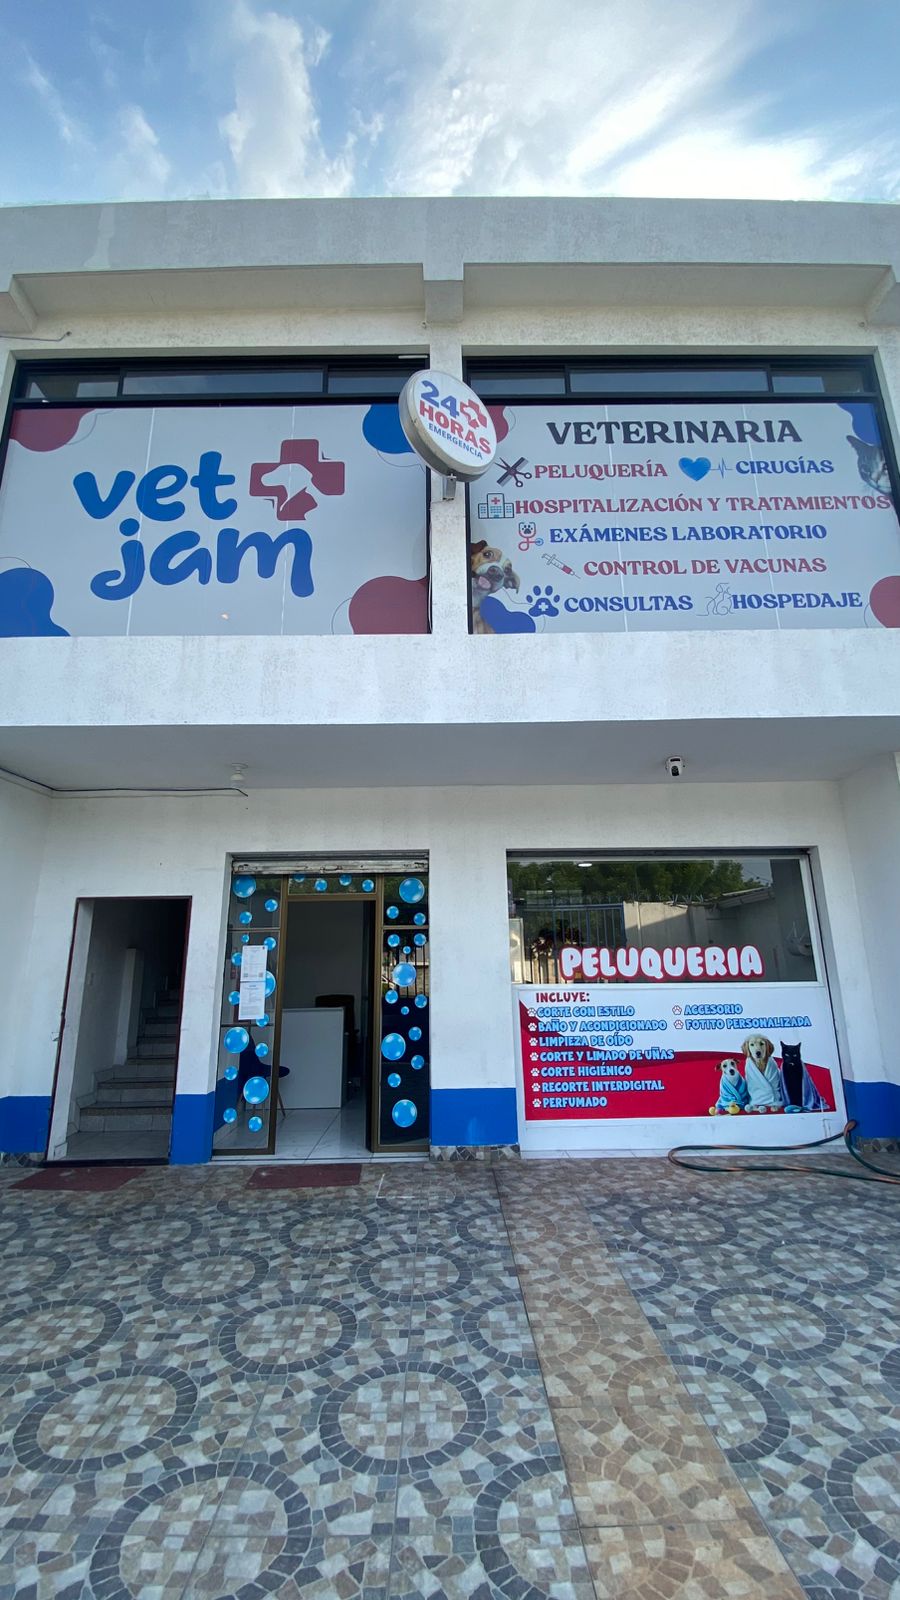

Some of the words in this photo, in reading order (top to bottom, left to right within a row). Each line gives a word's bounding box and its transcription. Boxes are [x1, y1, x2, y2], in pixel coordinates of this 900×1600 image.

[421, 380, 459, 418] 24
[420, 400, 491, 454] HORAS
[546, 420, 802, 445] VETERINARIA
[428, 423, 483, 460] EMERGENCIA
[534, 459, 668, 480] PELUQUERÍA
[735, 456, 834, 474] CIRUGÍAS
[73, 451, 237, 521] vet
[515, 493, 703, 514] HOSPITALIZACIÓN
[707, 497, 720, 511] Y
[726, 495, 891, 511] TRATAMIENTOS
[550, 523, 668, 543] EXÁMENES
[672, 525, 827, 541] LABORATORIO
[90, 518, 314, 601] jam
[583, 560, 687, 576] CONTROL
[691, 559, 720, 574] DE
[724, 558, 827, 573] VACUNAS
[564, 595, 693, 613] CONSULTAS
[731, 592, 863, 609] HOSPEDAJE
[560, 944, 765, 980] PELUQUERIA
[536, 992, 590, 1003] INCLUYE:
[536, 1006, 571, 1017] CORTE
[572, 1006, 595, 1017] CON
[597, 1005, 635, 1017] ESTILO
[684, 1004, 743, 1015] ACCESORIO
[538, 1019, 568, 1032] BAÑO
[569, 1021, 578, 1032] Y
[579, 1020, 667, 1032] ACONDICIONADO
[685, 1018, 725, 1030] FOTITO
[726, 1016, 812, 1029] PERSONALIZADA
[538, 1035, 589, 1047] LIMPIEZA
[590, 1035, 605, 1047] DE
[606, 1032, 634, 1046] OÍDO
[539, 1051, 575, 1062] CORTE
[576, 1051, 584, 1062] Y
[586, 1050, 628, 1061] LIMADO
[629, 1050, 646, 1061] DE
[646, 1047, 675, 1060] UÑAS
[540, 1066, 575, 1077] CORTE
[577, 1062, 633, 1077] HIGIÉNICO
[541, 1081, 590, 1092] RECORTE
[591, 1080, 665, 1092] INTERDIGITAL
[542, 1096, 608, 1108] PERFUMADO
